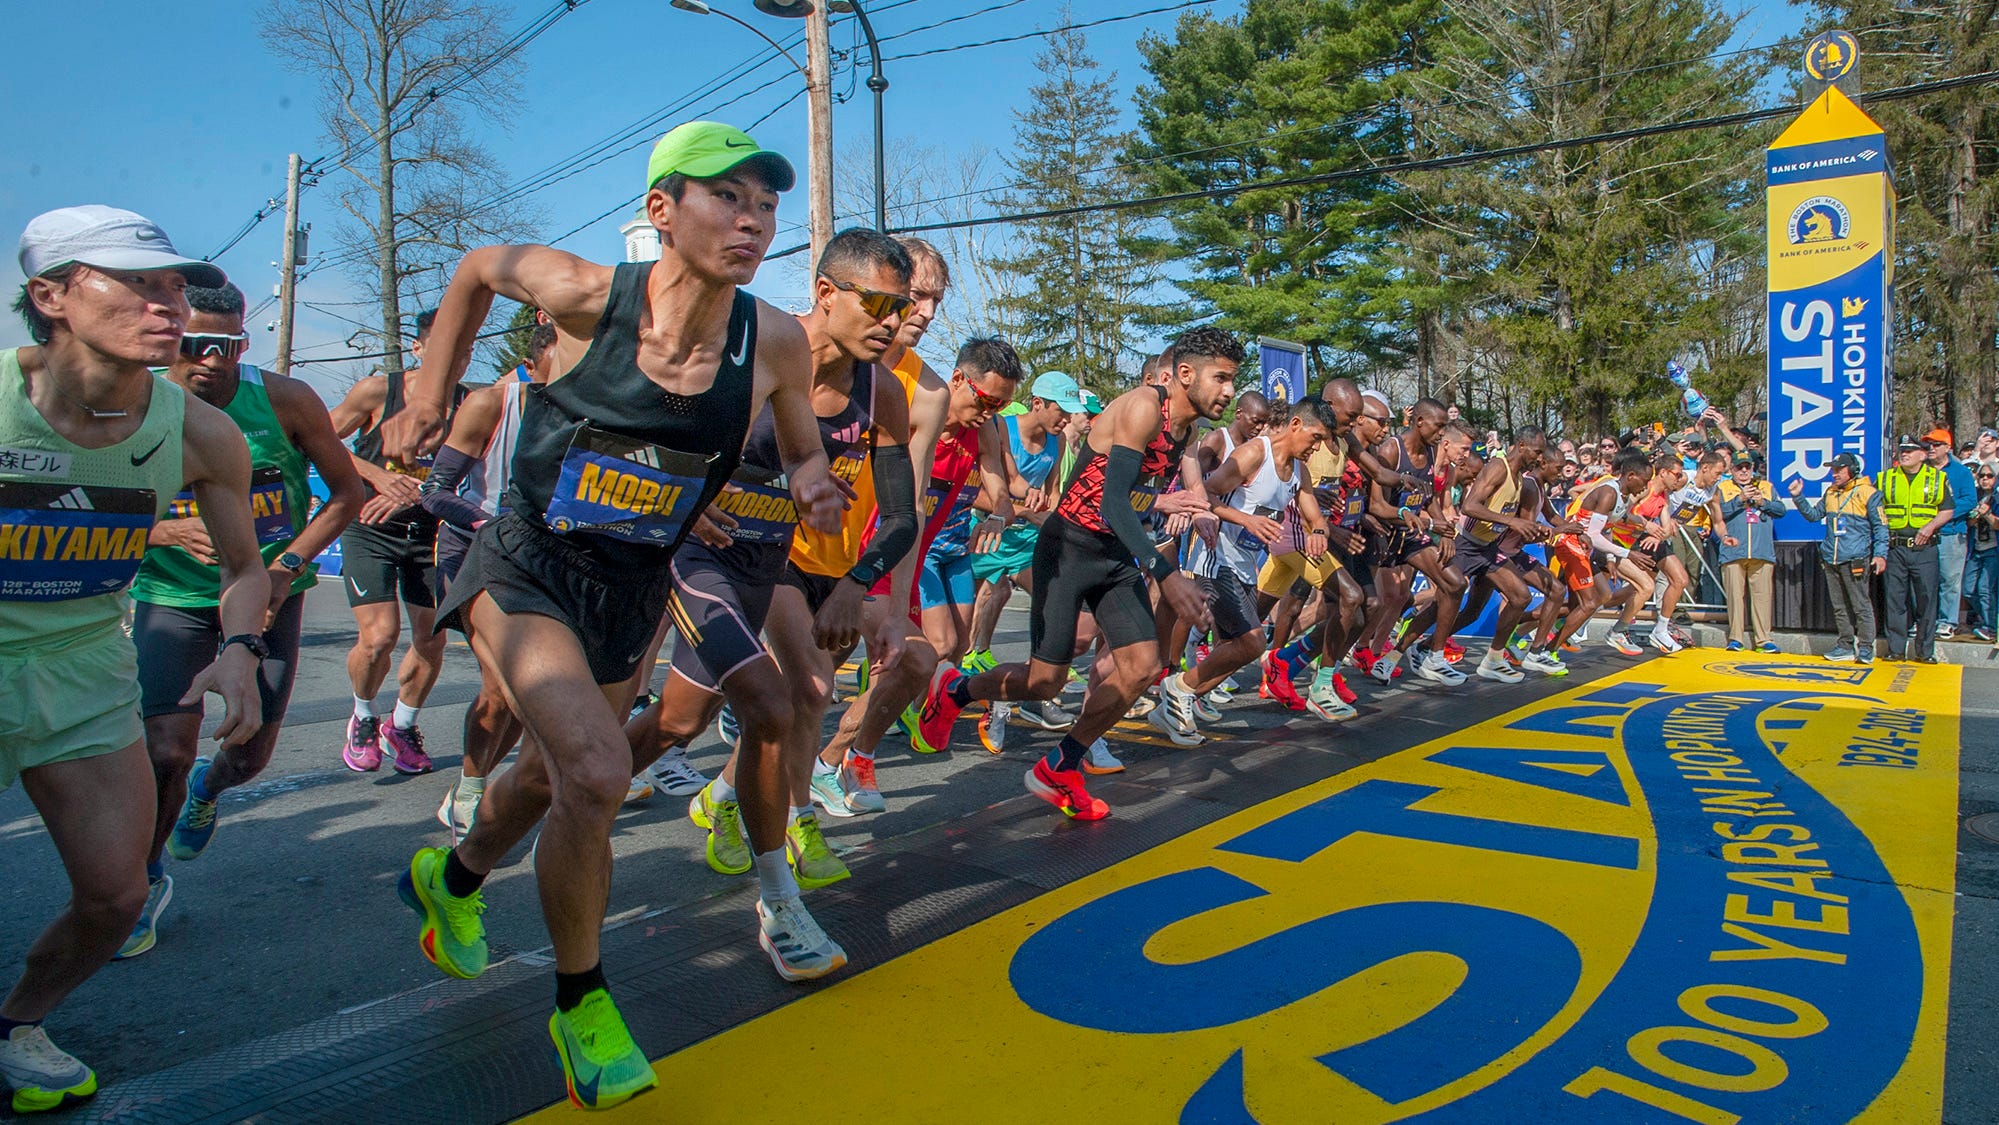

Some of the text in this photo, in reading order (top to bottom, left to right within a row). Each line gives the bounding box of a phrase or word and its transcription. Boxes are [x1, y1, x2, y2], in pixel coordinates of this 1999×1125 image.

[1772, 156, 1856, 174] BANK OF AMERICA
[1793, 198, 1821, 221] BOSTON
[1824, 198, 1849, 234] MARATHON
[1780, 245, 1851, 258] BANK OF AMERICA
[0, 450, 62, 474] 森ビル
[2, 587, 81, 596] MARATHON
[32, 580, 83, 588] BOSTON
[1662, 694, 1763, 784] HOPKINTON
[1838, 706, 1928, 770] 1924-2024
[1692, 786, 1795, 817] IN
[1709, 821, 1850, 965] YEARS
[1561, 983, 1830, 1125] 100
